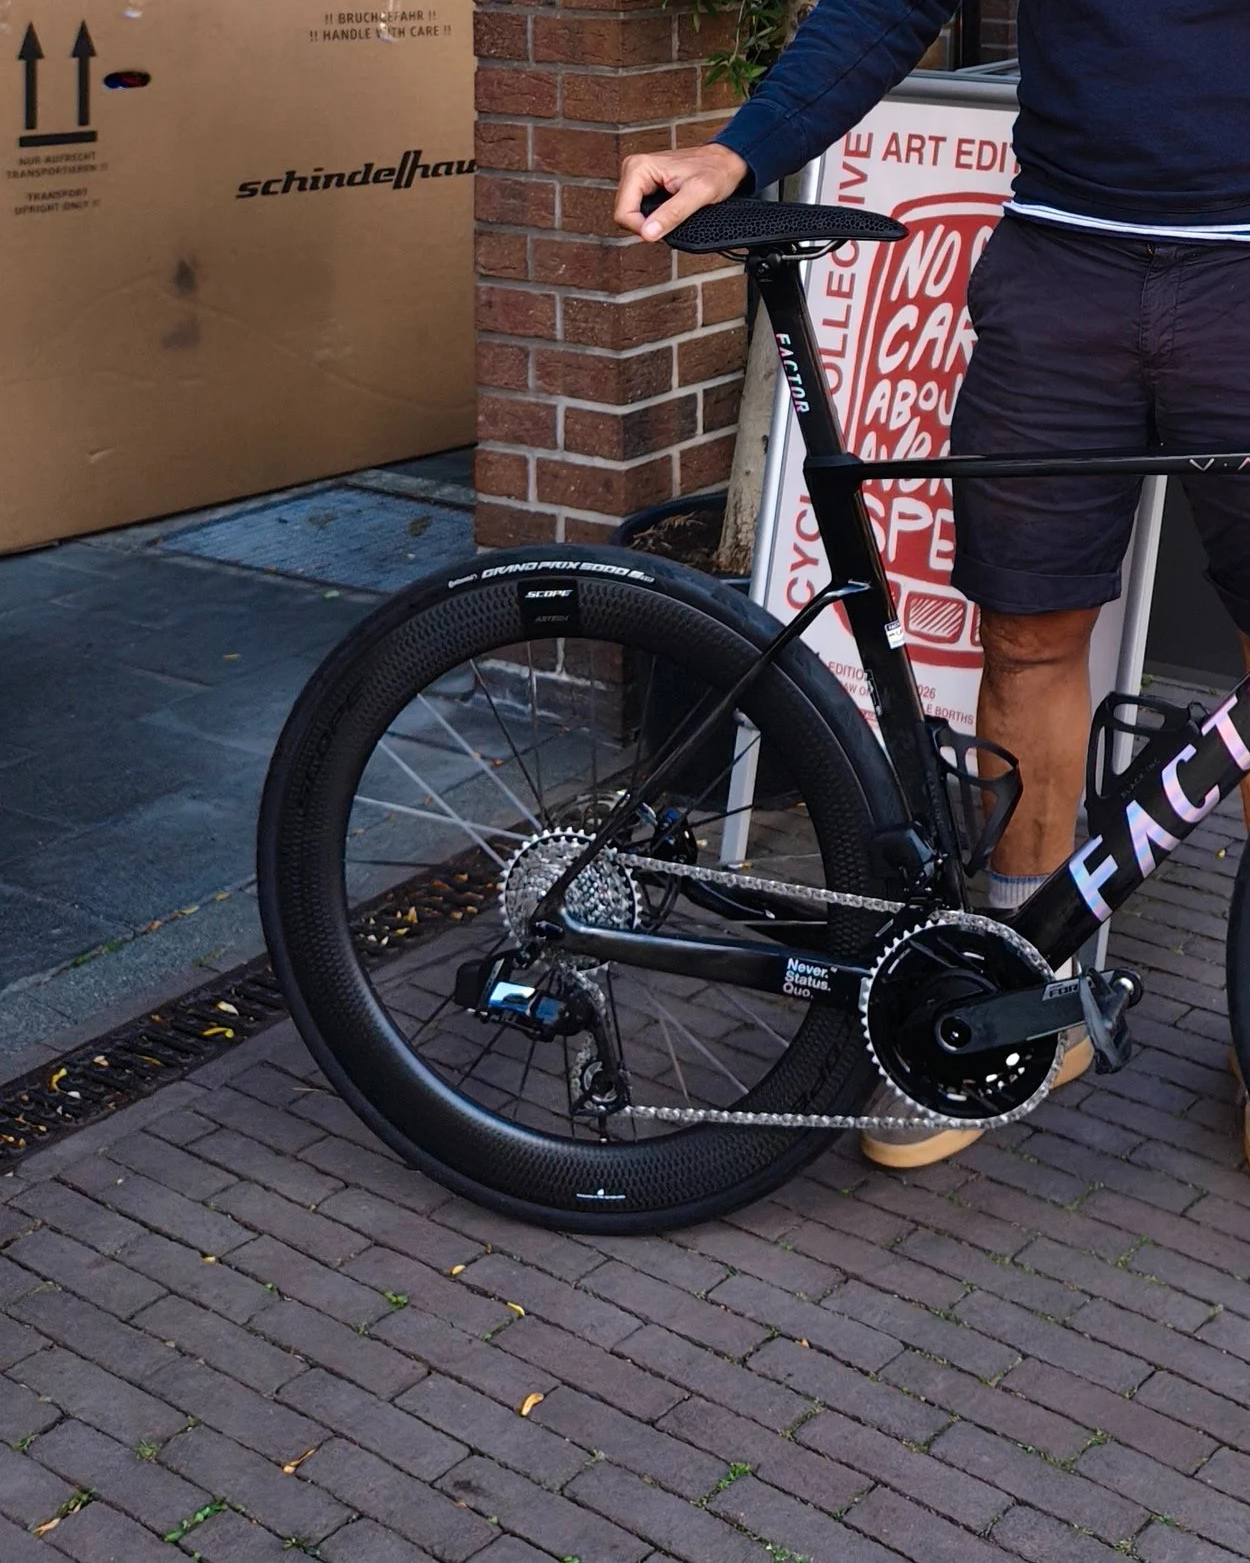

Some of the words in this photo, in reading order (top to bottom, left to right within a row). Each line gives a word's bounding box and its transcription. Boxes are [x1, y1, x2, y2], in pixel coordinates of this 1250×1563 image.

[323, 28, 371, 41] HANDLE
[410, 25, 439, 37] CARE
[882, 132, 947, 167] ART
[890, 224, 962, 302] NO
[776, 333, 810, 414] FACTOR
[481, 562, 538, 579] GRAND
[538, 561, 580, 570] PRIX
[579, 562, 631, 576] 5000
[524, 589, 574, 599] SCOPE
[935, 706, 974, 725] BORTHS
